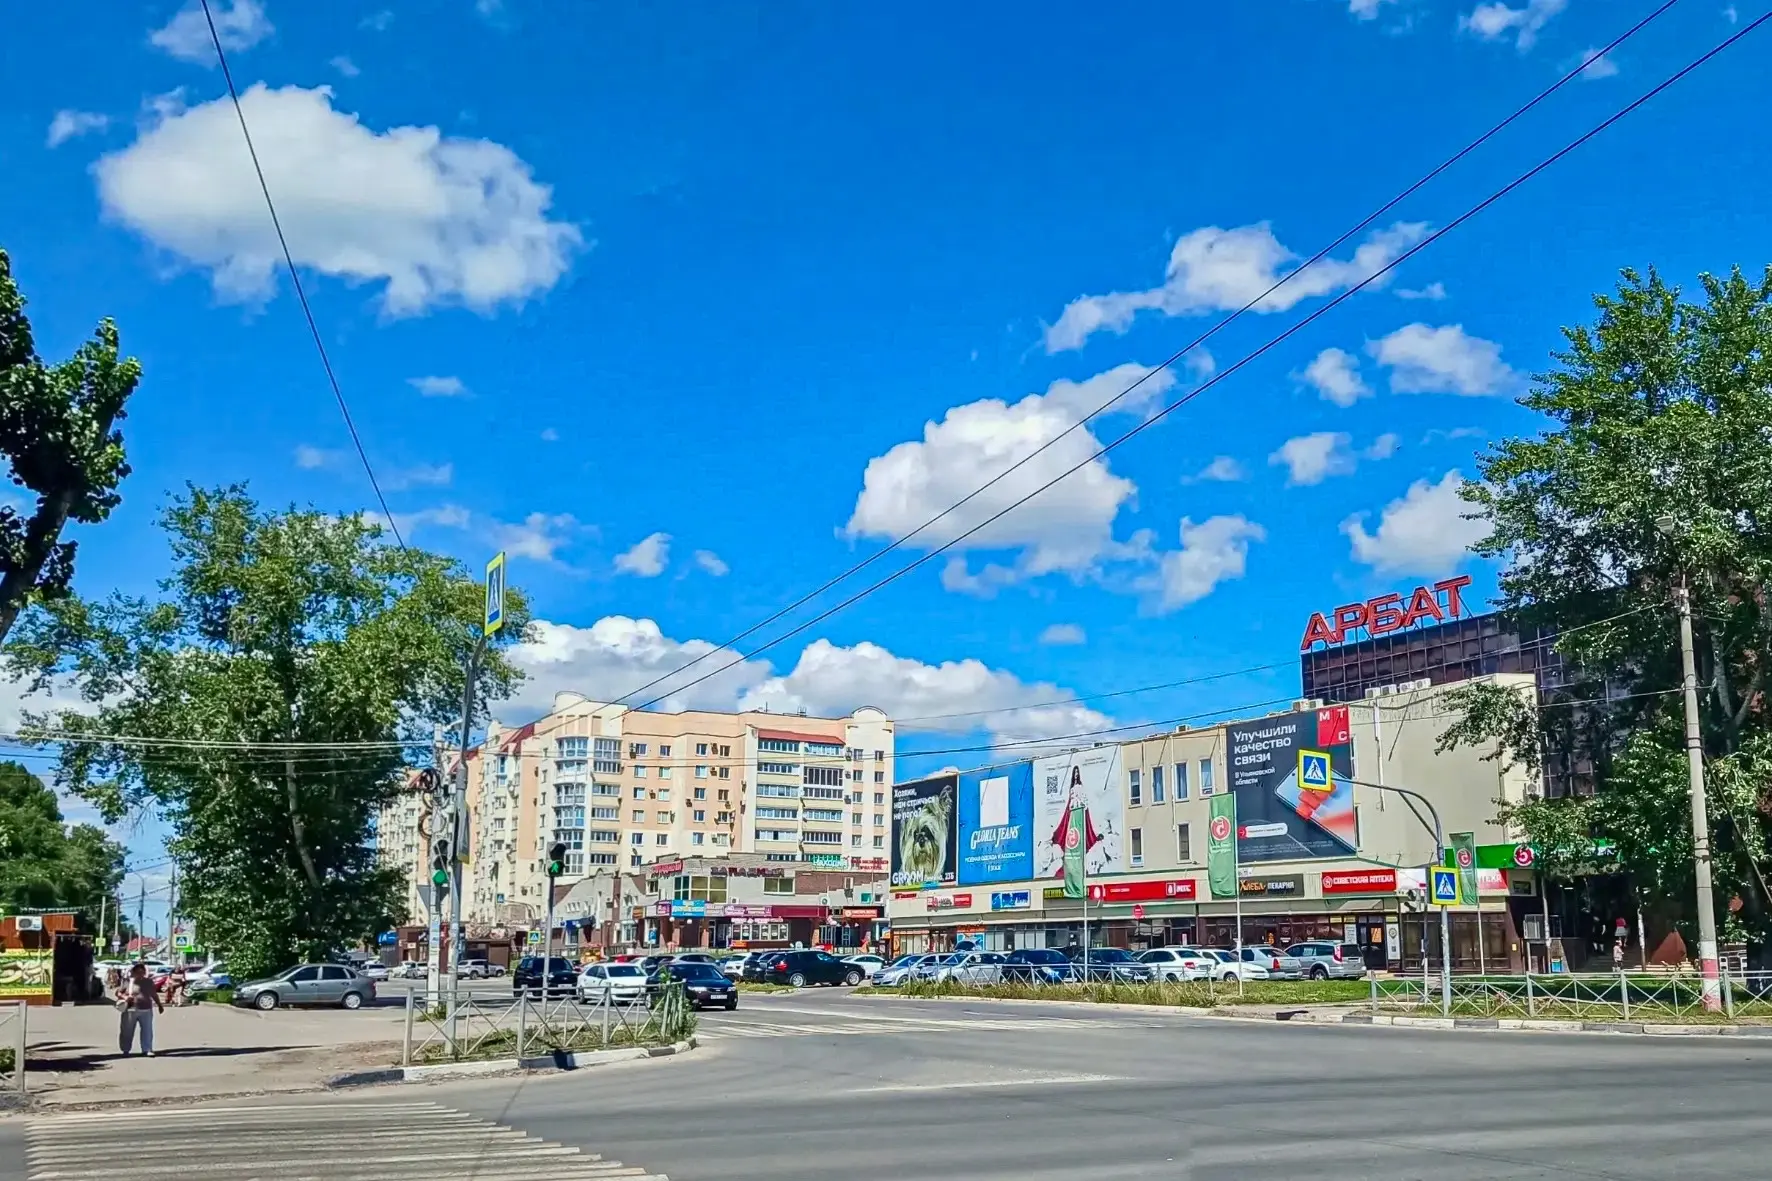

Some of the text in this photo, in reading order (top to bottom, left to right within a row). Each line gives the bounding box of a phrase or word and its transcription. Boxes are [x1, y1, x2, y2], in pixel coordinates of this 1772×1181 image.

[1302, 575, 1471, 650] АРБАТ
[1233, 725, 1297, 743] Улучшили
[1234, 737, 1292, 755] качество
[1234, 753, 1271, 766] связи
[1240, 767, 1276, 779] Ульяновской
[1235, 778, 1259, 786] области
[970, 824, 1023, 850] GLORIA JEANS
[892, 870, 924, 887] GROOM
[1267, 881, 1295, 890] ПЕКАРНЯ
